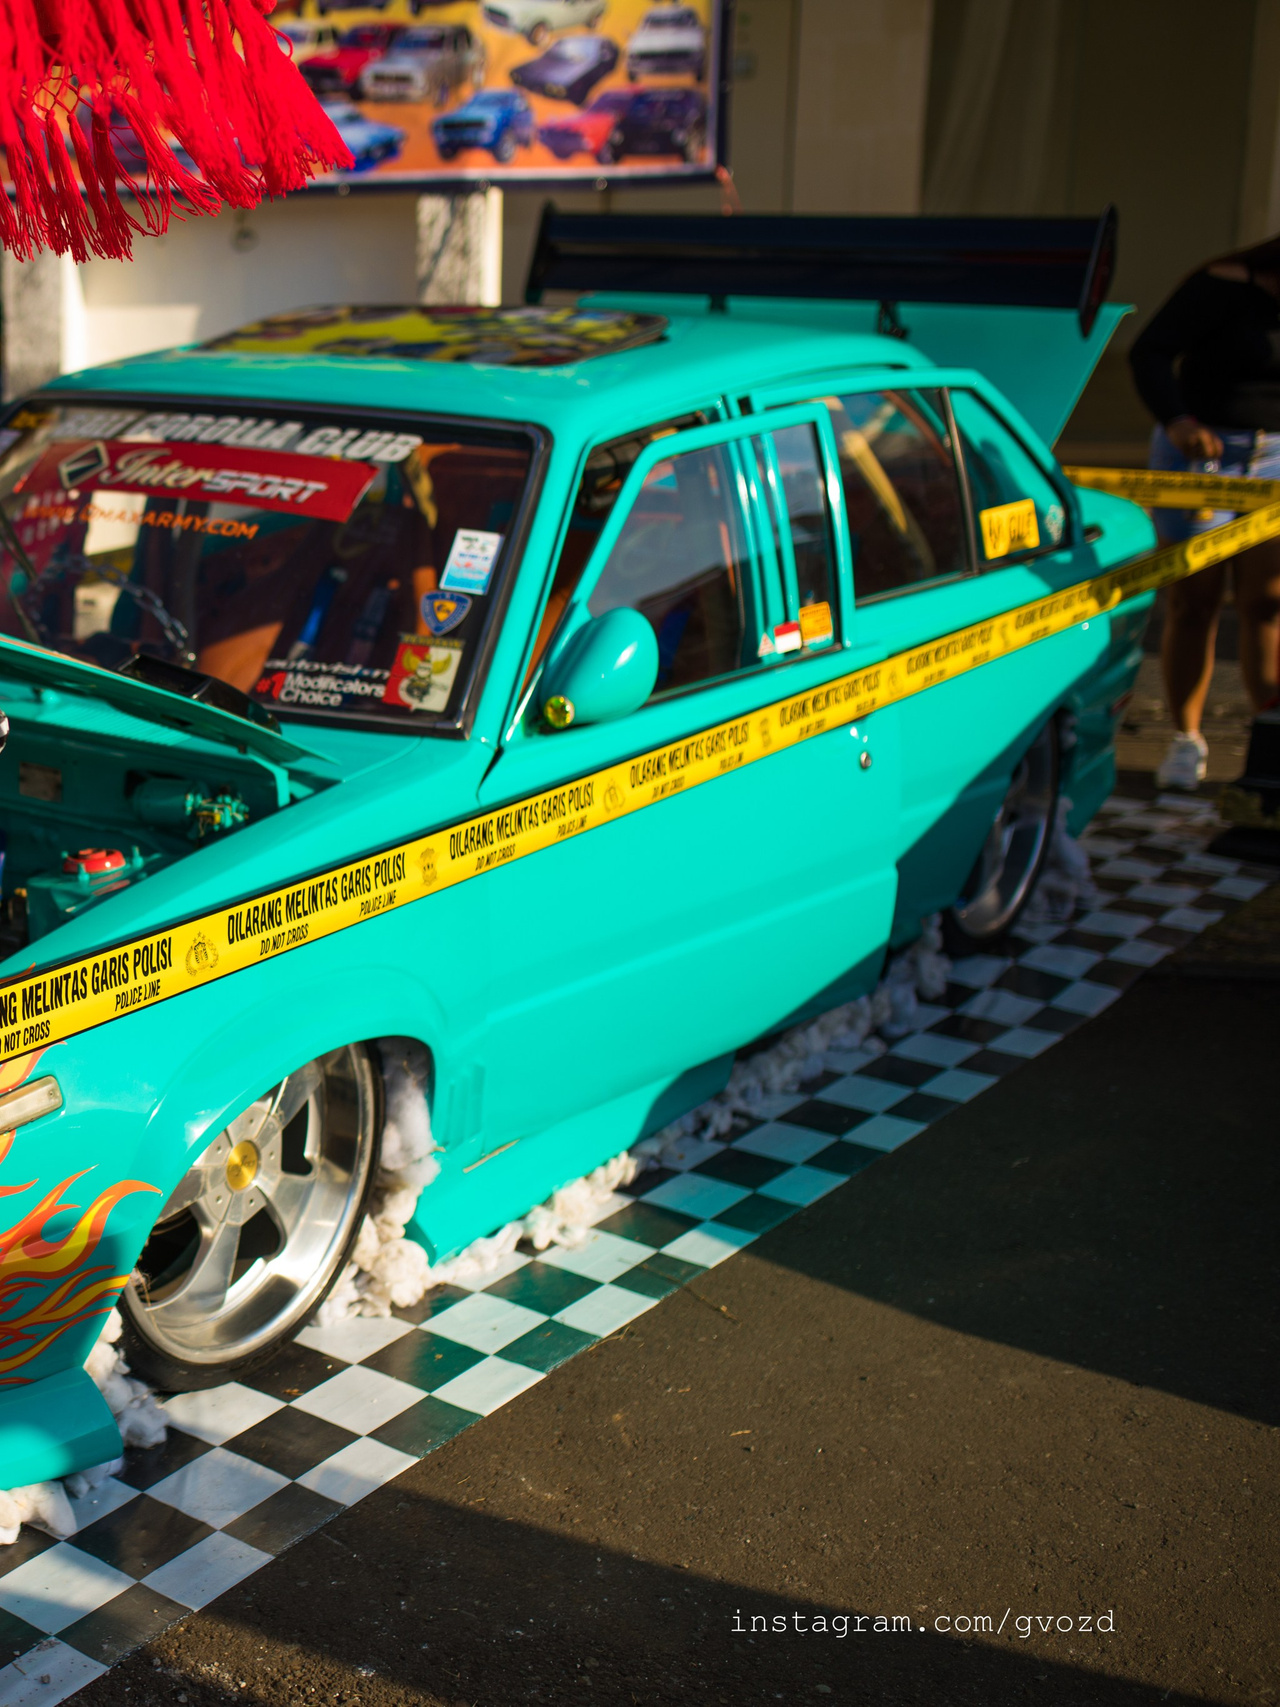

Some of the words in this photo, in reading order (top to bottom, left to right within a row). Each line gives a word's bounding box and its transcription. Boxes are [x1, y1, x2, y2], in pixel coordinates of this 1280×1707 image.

[133, 411, 304, 449] COROLLA
[297, 427, 423, 462] CLUB
[256, 672, 286, 699] #1
[283, 671, 387, 698] Modificators
[279, 687, 342, 707] Choice
[449, 819, 494, 861] DILARANG
[496, 803, 539, 845] MELINTAS
[541, 791, 566, 825] GARIS
[568, 781, 595, 814] POLISI
[227, 897, 283, 945] DILARANG
[285, 877, 338, 924] MELINTAS
[340, 864, 372, 902] GARIS
[373, 851, 406, 889] POLISI
[359, 896, 381, 917] POLICE
[381, 889, 397, 909] LINE
[259, 939, 270, 956] DO
[271, 932, 286, 953] NOT
[286, 923, 309, 946] CROSS
[21, 967, 88, 1020] MELINTAS
[91, 951, 130, 996] GARIS
[133, 936, 173, 981] POLISI
[114, 987, 143, 1012] POLICE
[143, 979, 161, 1001] LINE
[4, 1031, 21, 1054] NOT
[23, 1020, 51, 1047] CROSS
